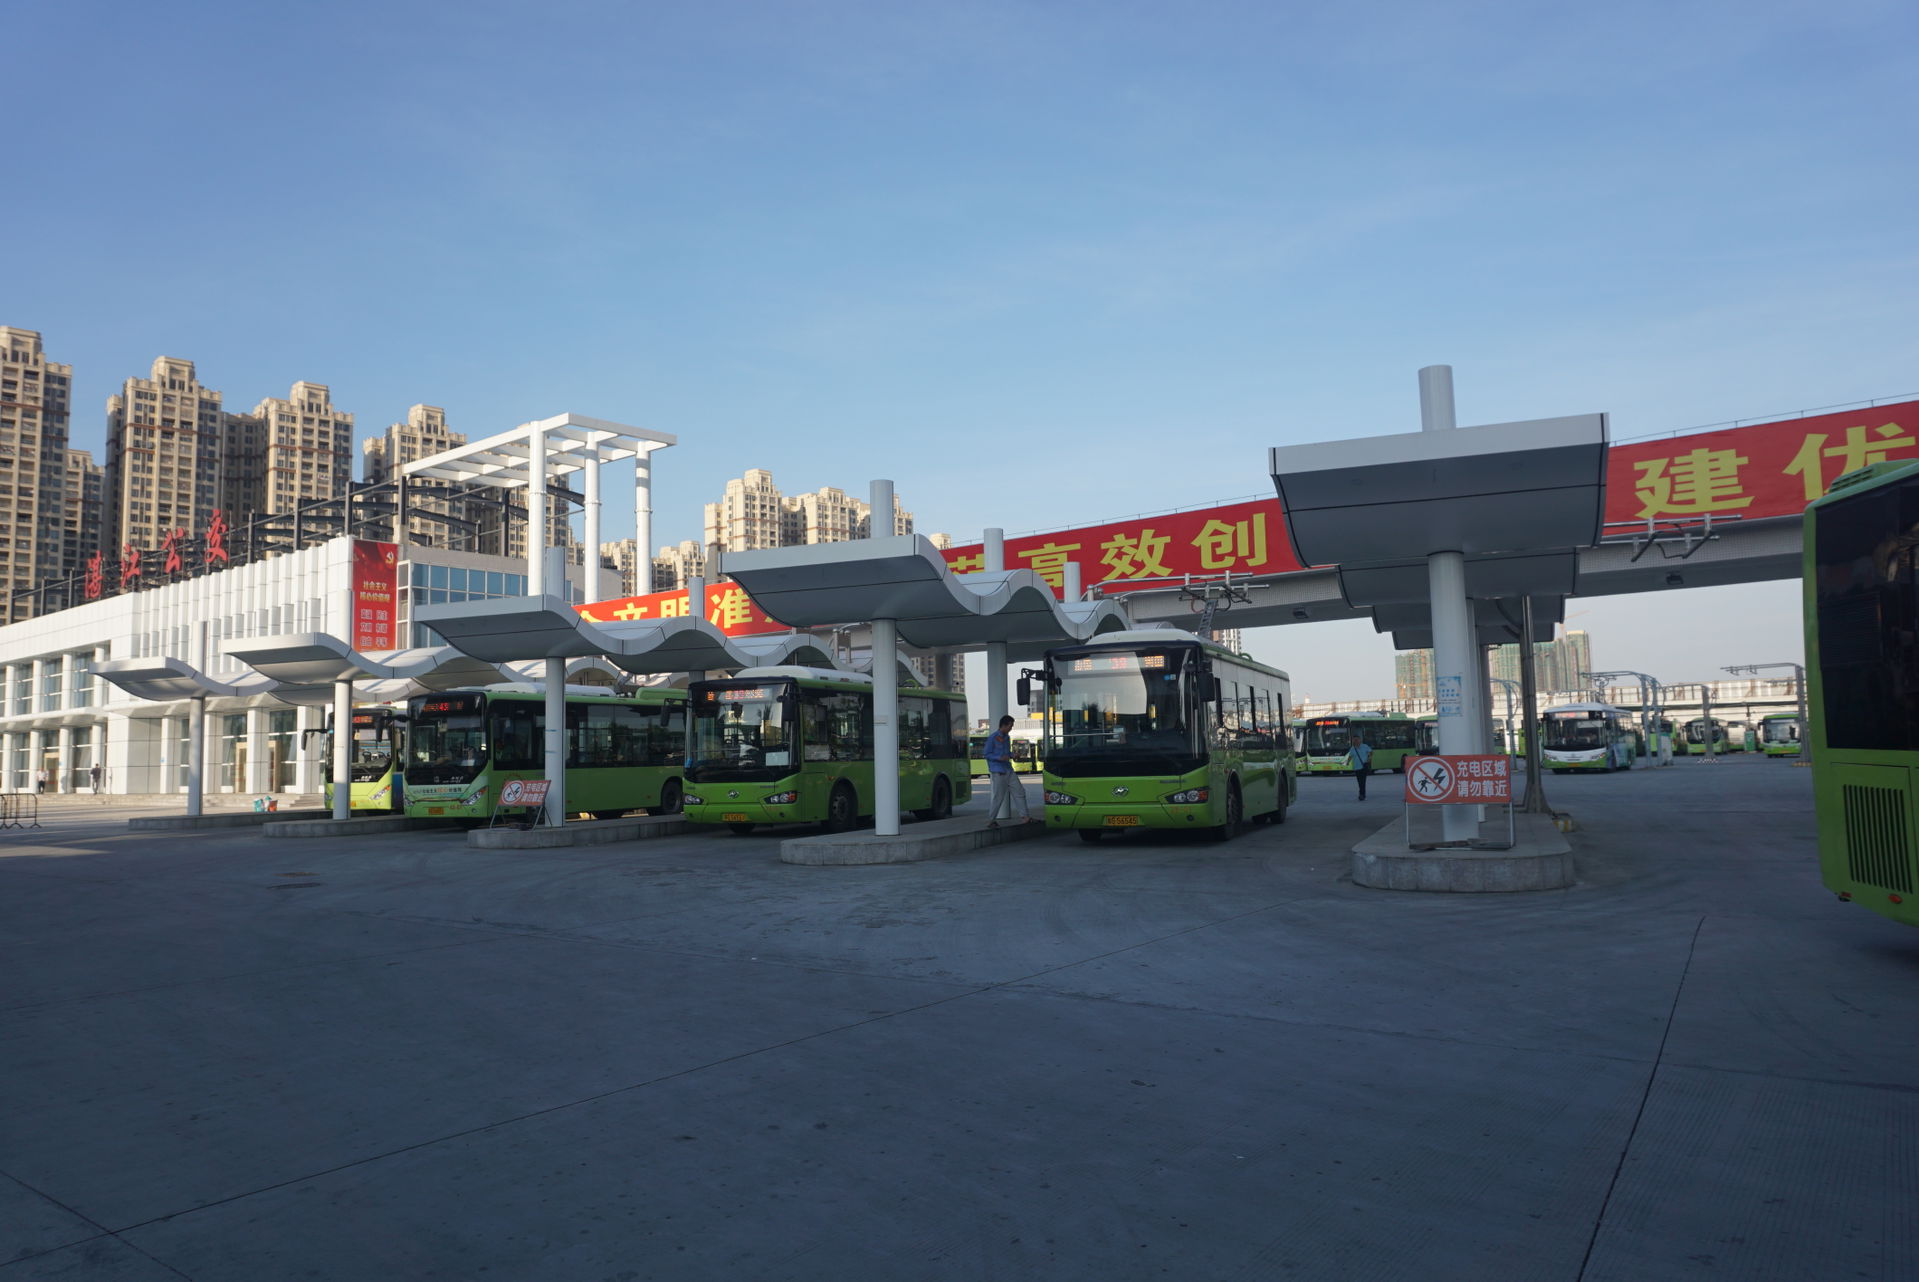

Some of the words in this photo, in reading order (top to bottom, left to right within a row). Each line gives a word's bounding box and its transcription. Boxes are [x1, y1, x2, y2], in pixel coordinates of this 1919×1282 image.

[1456, 760, 1507, 778] 充电区域
[1457, 780, 1508, 798] 请勿靠近
